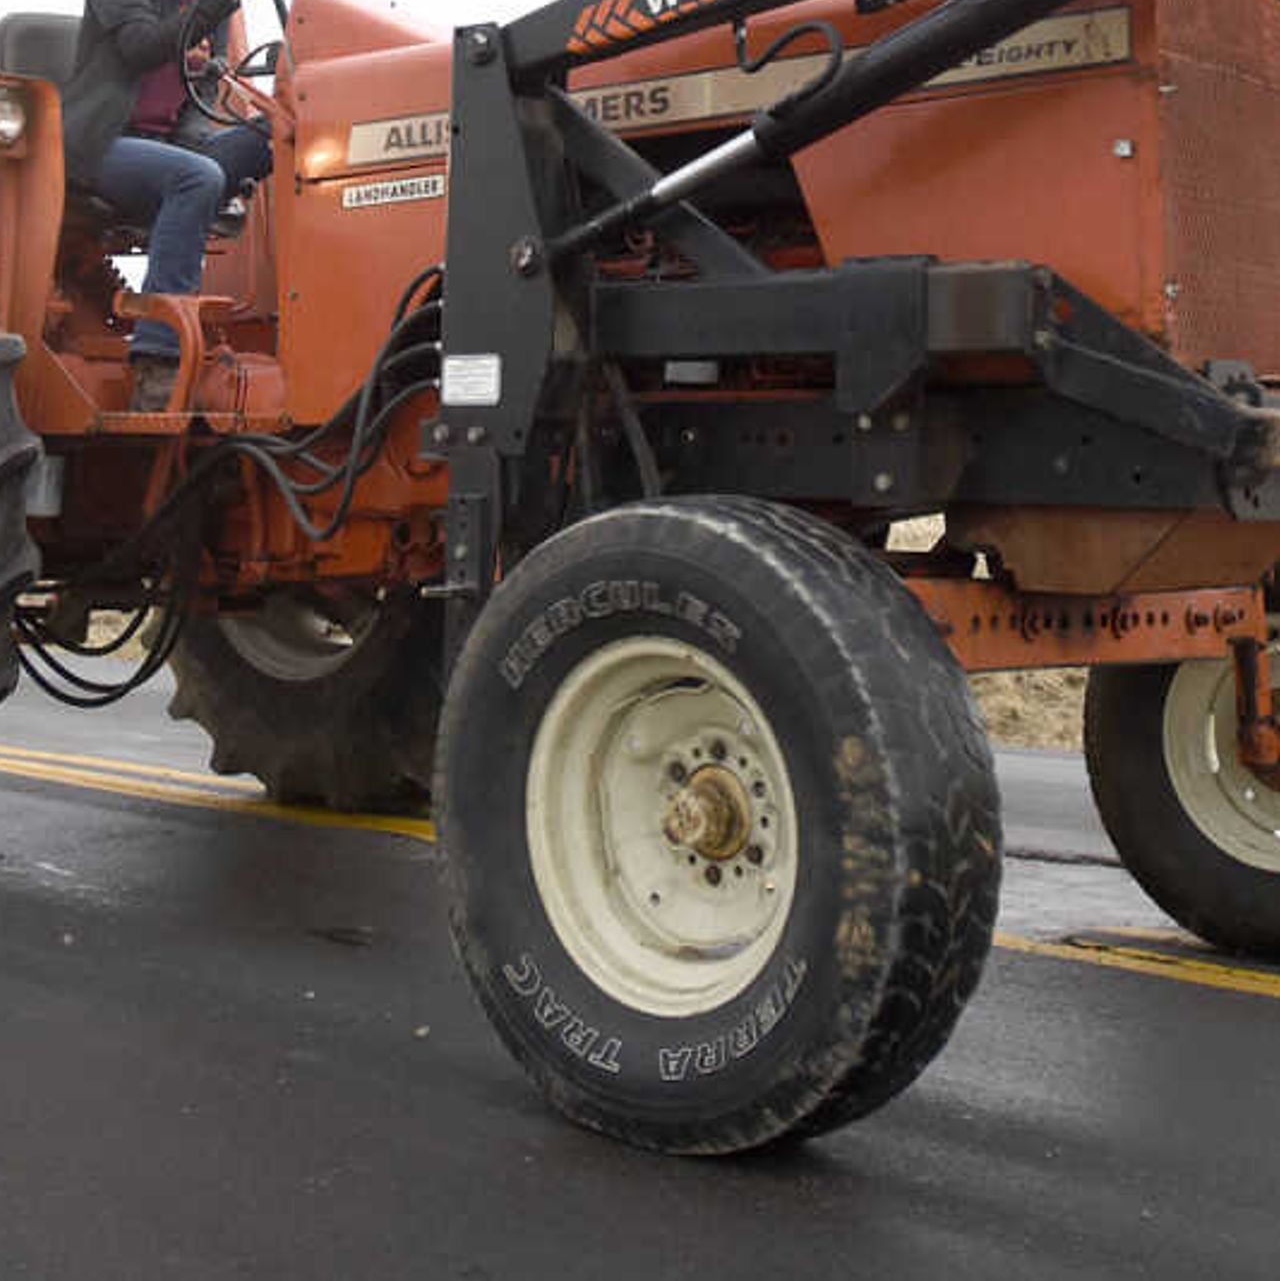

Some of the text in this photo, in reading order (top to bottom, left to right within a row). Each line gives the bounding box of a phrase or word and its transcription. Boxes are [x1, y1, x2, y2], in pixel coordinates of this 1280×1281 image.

[383, 119, 449, 152] ALLI
[348, 179, 438, 203] LANDHANDLER
[500, 580, 742, 690] HERCULES
[503, 952, 808, 1081] TERRA TRAC
